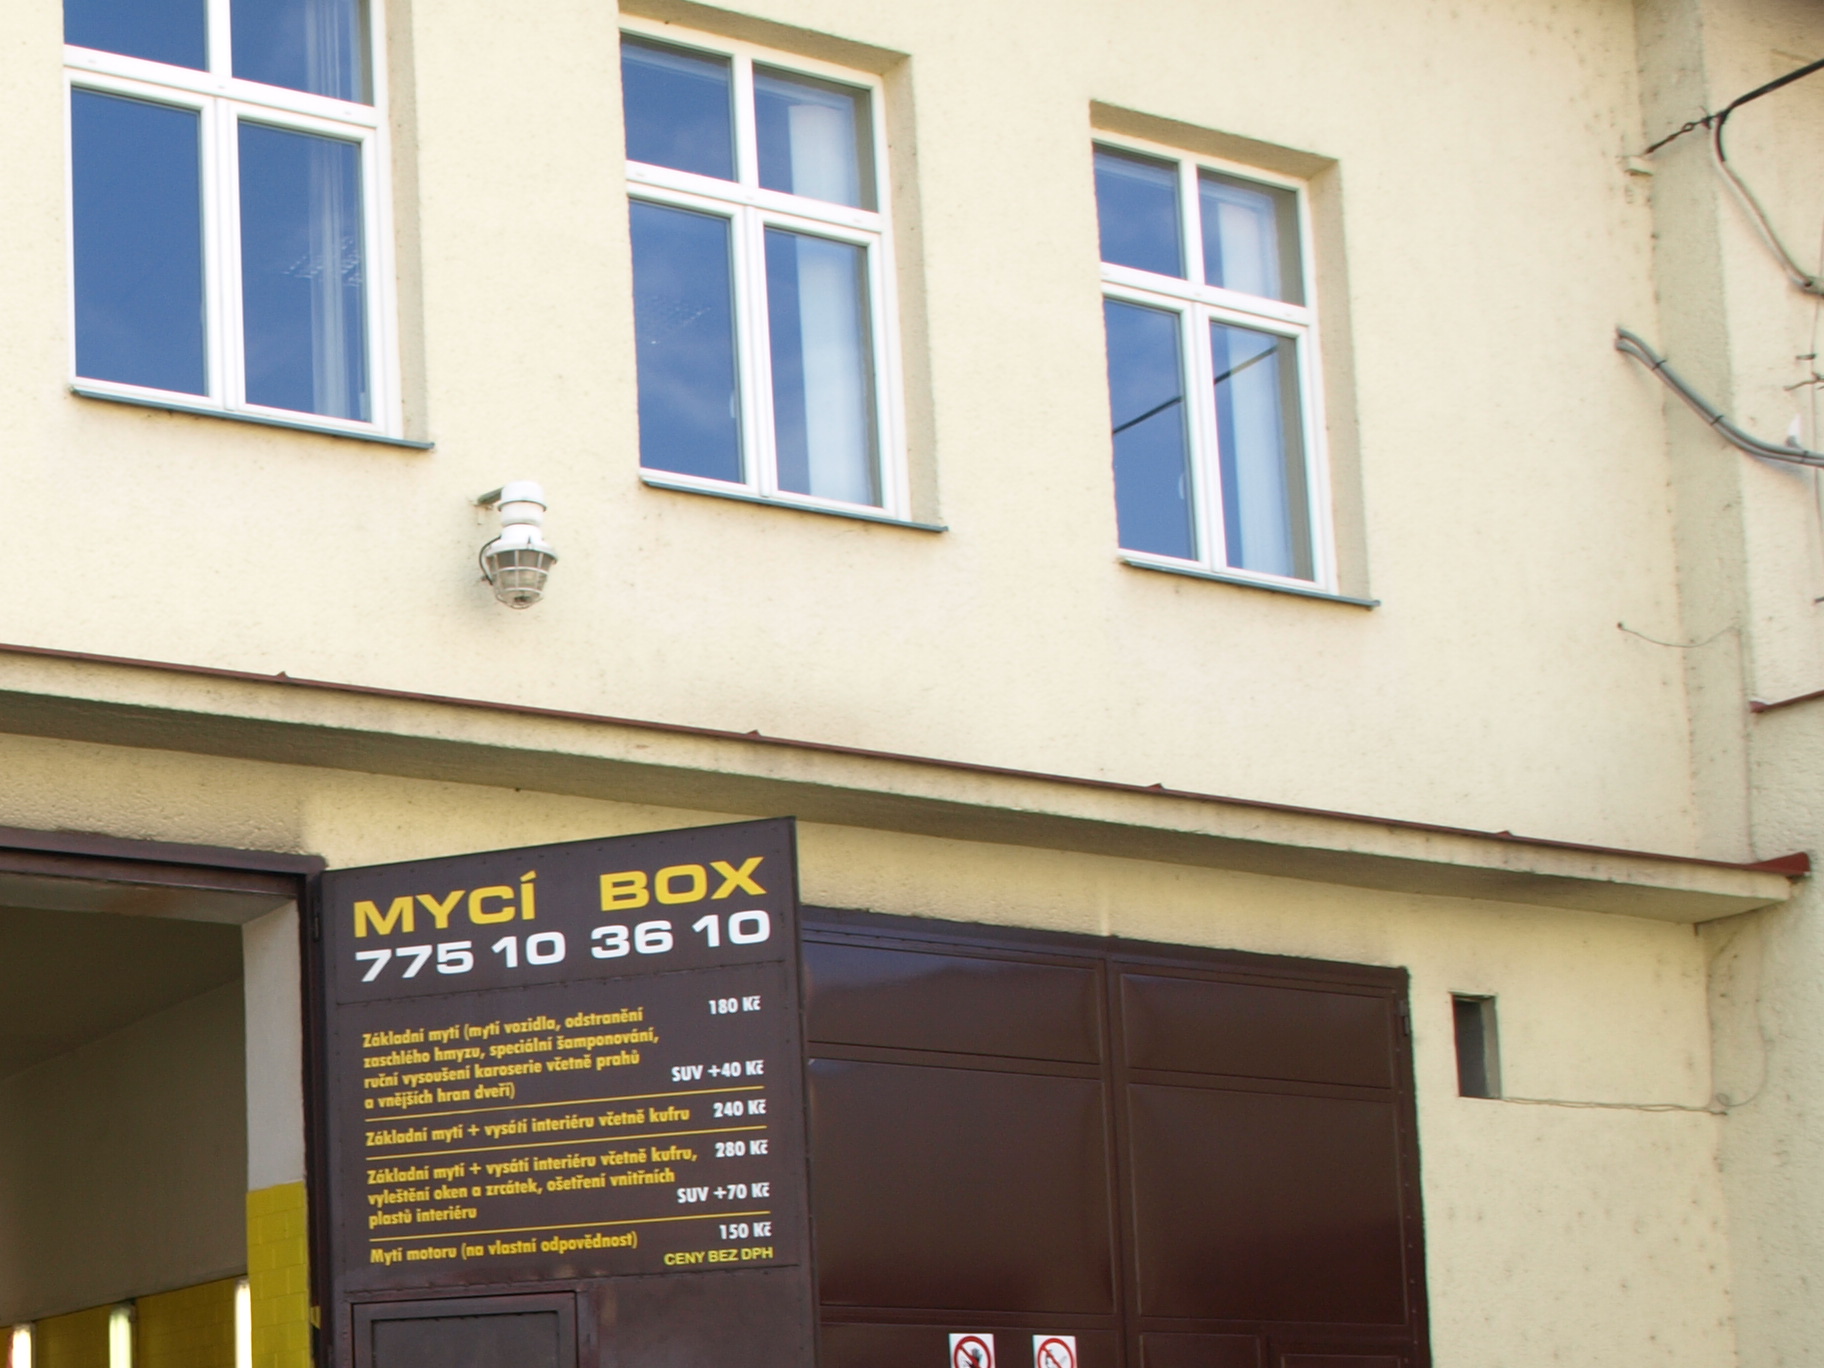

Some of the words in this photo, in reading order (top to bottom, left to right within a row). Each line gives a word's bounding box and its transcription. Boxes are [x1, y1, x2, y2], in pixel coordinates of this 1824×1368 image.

[353, 870, 537, 938] MYCÍ
[599, 856, 767, 912] BOX
[354, 940, 474, 983] 775
[491, 931, 566, 968] 10
[590, 919, 674, 959] 36
[692, 909, 771, 948] 10
[708, 998, 738, 1015] 180
[741, 995, 761, 1011] Kč
[362, 1028, 424, 1048] Základní
[428, 1025, 460, 1043] mytí
[503, 1016, 561, 1034] vozidla,
[565, 1007, 644, 1028] odstranění
[363, 1049, 430, 1068] zaschlého
[434, 1046, 485, 1063] hmyzu,
[489, 1036, 552, 1059] speciální
[556, 1027, 660, 1050] šamponování,
[364, 1072, 399, 1088] ruční
[402, 1065, 471, 1087] vysoušení
[474, 1060, 542, 1078] karoserie
[546, 1054, 592, 1072] včetně
[596, 1050, 640, 1071] prahů
[671, 1064, 704, 1082] SUV
[707, 1061, 741, 1078] +40
[745, 1060, 764, 1076] Kč
[364, 1098, 374, 1109] a
[378, 1089, 433, 1109] vnějších
[437, 1087, 470, 1103] hran
[474, 1081, 515, 1099] dveří)
[713, 1100, 744, 1118] 240
[747, 1099, 767, 1115] Kč
[365, 1127, 428, 1146] Základní
[431, 1124, 463, 1143] mytí
[468, 1124, 480, 1136] +
[484, 1118, 528, 1139] vysátí
[531, 1114, 594, 1132] interiéru
[598, 1109, 645, 1127] včetně
[648, 1106, 690, 1123] kufru
[715, 1141, 746, 1158] 280
[749, 1139, 769, 1155] Kč
[367, 1166, 430, 1185] Základní
[433, 1162, 465, 1181] mytí
[469, 1163, 482, 1174] +
[485, 1157, 529, 1178] vysátí
[533, 1153, 596, 1171] interiéru
[600, 1148, 647, 1166] včetně
[650, 1145, 698, 1162] kufru,
[367, 1187, 430, 1208] vyleštění
[433, 1184, 468, 1200] oken
[471, 1185, 482, 1197] a
[485, 1178, 543, 1196] zrcátek,
[546, 1172, 606, 1192] ošetření
[609, 1167, 676, 1186] vnitřních
[676, 1187, 709, 1204] SUV
[713, 1183, 748, 1200] +70
[751, 1182, 770, 1198] Kč
[368, 1208, 412, 1230] plastů
[416, 1205, 478, 1223] interiéru
[719, 1223, 749, 1240] 150
[753, 1221, 772, 1238] Kč
[370, 1247, 403, 1266] Mytí
[406, 1247, 457, 1261] motoru
[461, 1242, 484, 1260] (na
[488, 1238, 537, 1255] vlastní
[540, 1230, 638, 1254] odpovědnost)
[664, 1251, 705, 1266] CENY
[707, 1248, 739, 1263] BEZ
[741, 1246, 774, 1260] DPH
